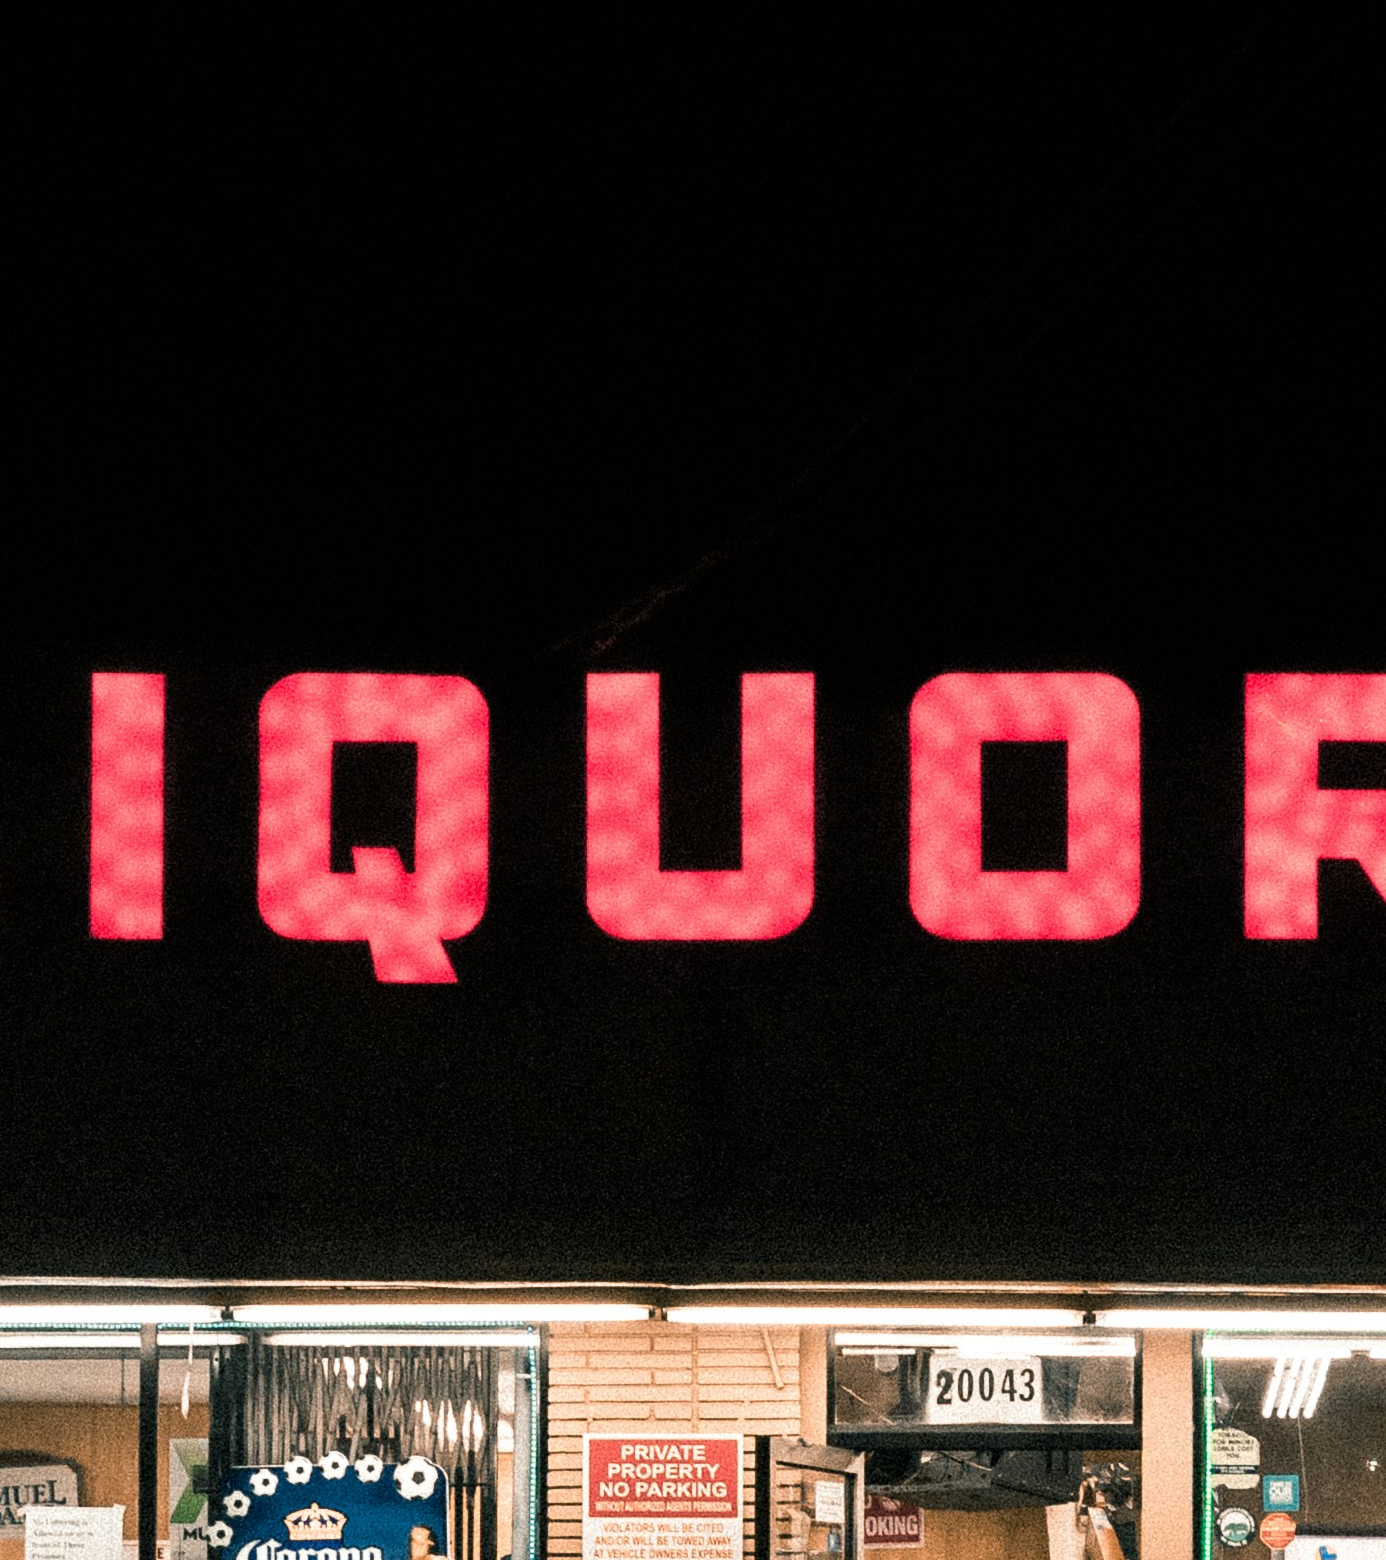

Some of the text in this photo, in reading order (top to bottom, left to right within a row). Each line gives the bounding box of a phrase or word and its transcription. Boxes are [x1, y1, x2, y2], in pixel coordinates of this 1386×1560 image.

[936, 1368, 1035, 1406] 20043
[620, 1444, 706, 1461] PRIVATE
[607, 1463, 719, 1480] PROPERTY
[598, 1481, 728, 1498] NO PARKING
[603, 1523, 724, 1534] VIOLATORS WILL BE CITED
[632, 1536, 655, 1546] WILL
[656, 1536, 669, 1546] BE
[671, 1536, 704, 1546] TOWED
[706, 1536, 732, 1546] AWAY
[593, 1549, 734, 1560] AT VEHICLE OWNERS EXPENSE
